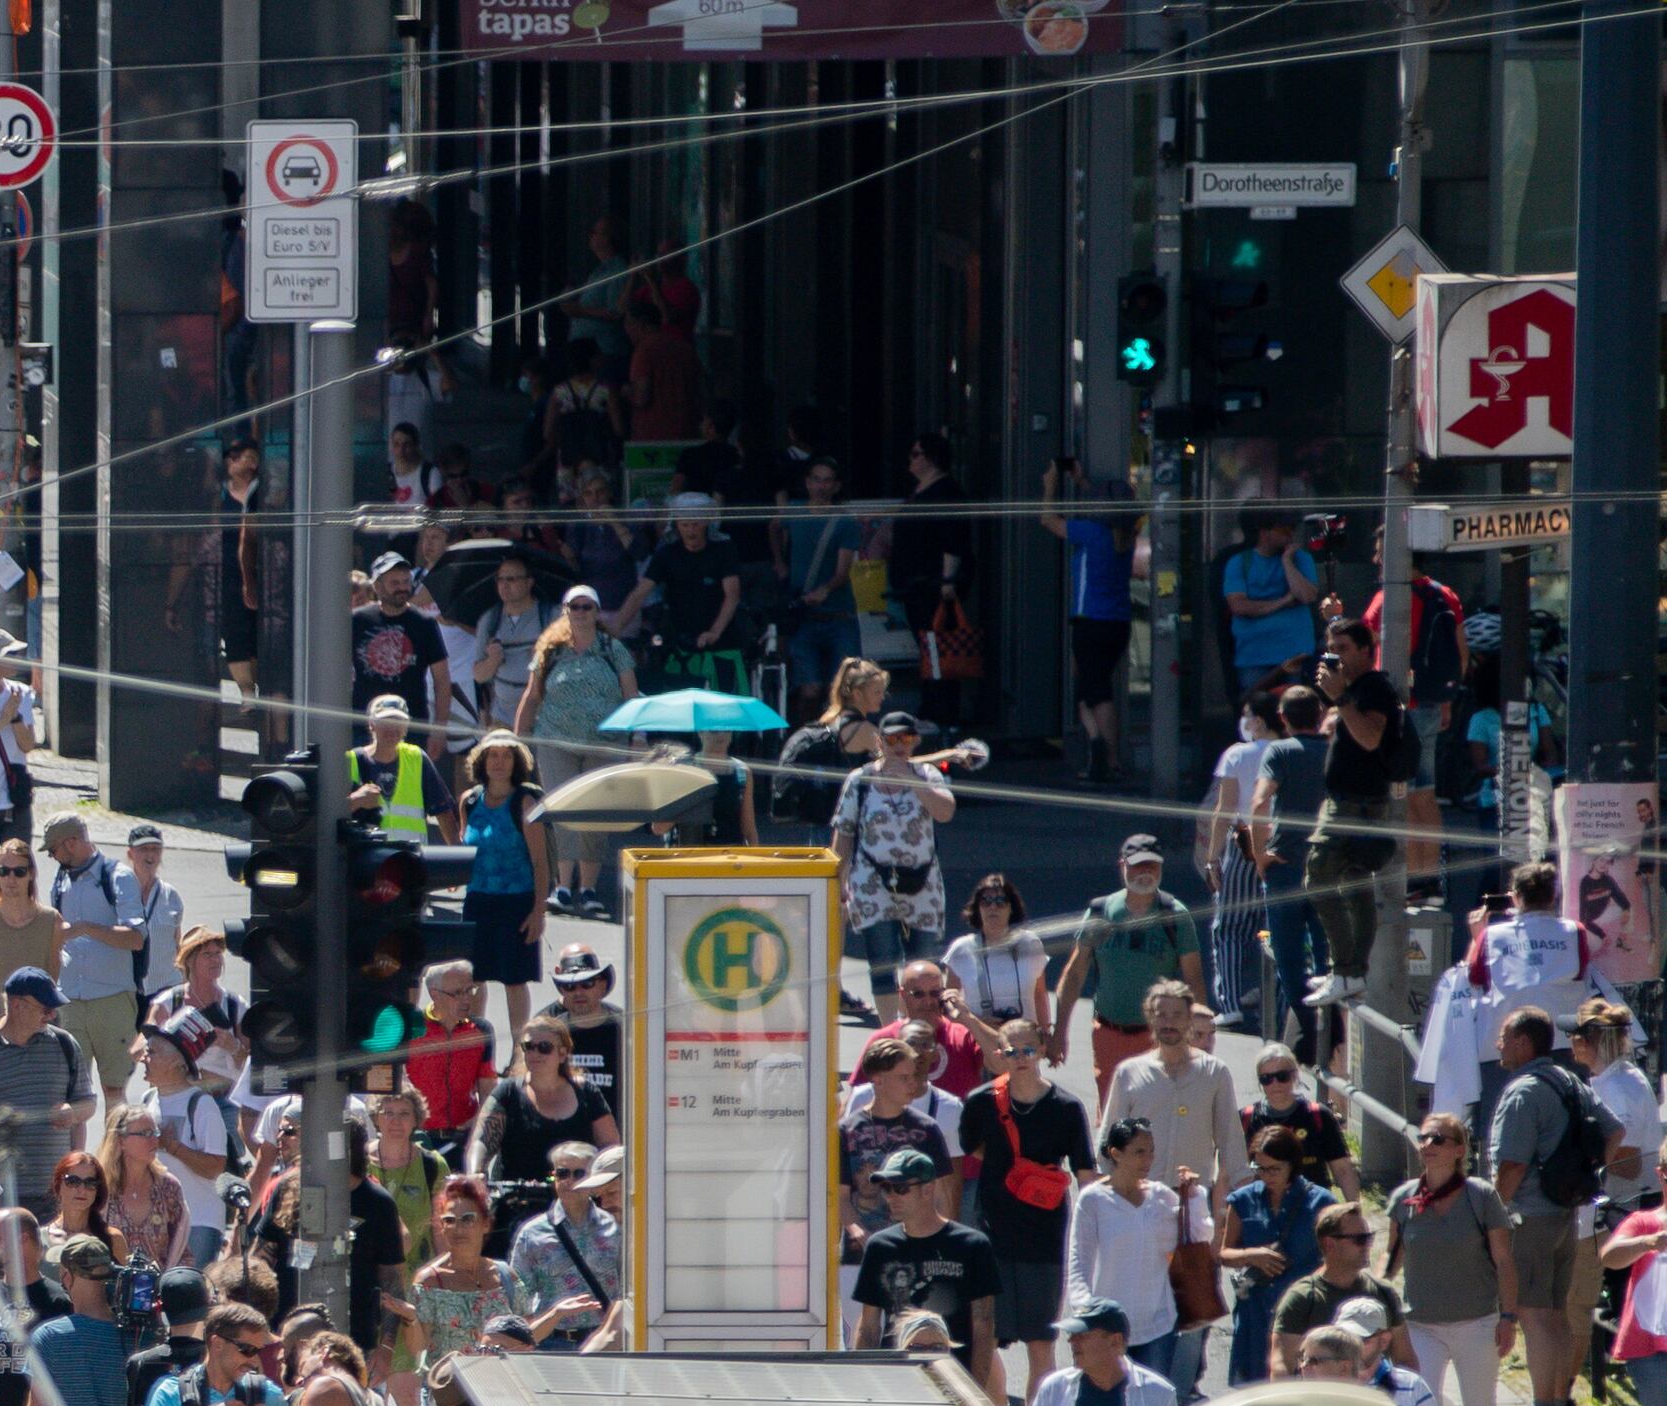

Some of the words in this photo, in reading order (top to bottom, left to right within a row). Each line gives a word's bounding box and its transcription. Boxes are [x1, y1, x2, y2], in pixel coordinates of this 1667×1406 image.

[478, 9, 570, 41] tapas
[1202, 172, 1344, 196] Dorotheenstraße
[271, 223, 308, 236] Diesel
[313, 223, 332, 236] bis
[273, 239, 303, 252] Euro
[271, 275, 331, 289] Anlieger
[290, 290, 314, 302] frei
[679, 1049, 700, 1061] M1
[713, 1048, 741, 1058] Mitte
[713, 1060, 732, 1070] Am
[681, 1095, 697, 1108] 12
[713, 1095, 741, 1105] Mitte
[713, 1107, 732, 1117] Am
[734, 1107, 805, 1120] Kupfergraben
